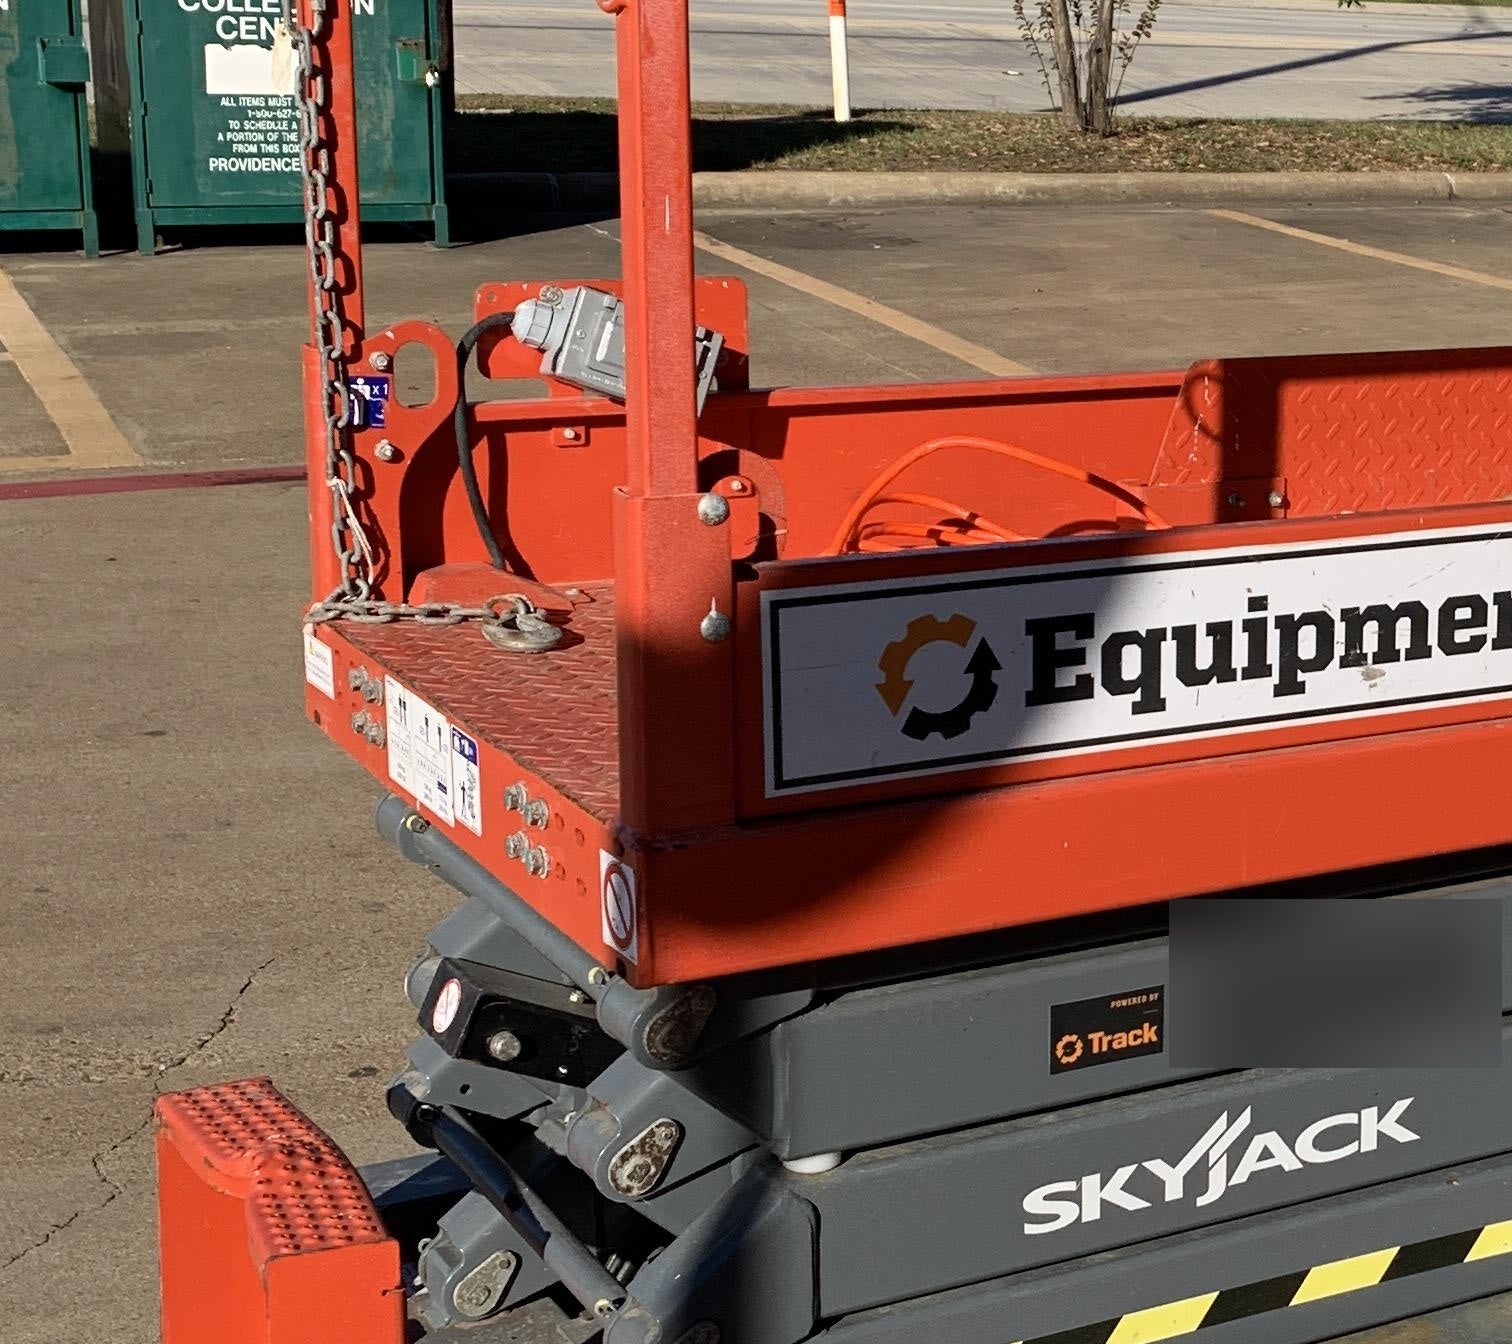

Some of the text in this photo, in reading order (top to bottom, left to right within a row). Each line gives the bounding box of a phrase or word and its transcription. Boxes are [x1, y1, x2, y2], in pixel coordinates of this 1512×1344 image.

[220, 96, 293, 107] ALL ITEMS MUST
[228, 120, 298, 130] TO SCHEDULE A
[217, 132, 299, 142] A PORTION OF THE
[232, 143, 300, 153] FROM THIS BOX
[208, 157, 302, 172] PROVIDENCE
[1087, 1022, 1159, 1054] Track
[1022, 1096, 1422, 1236] SKYJACK
